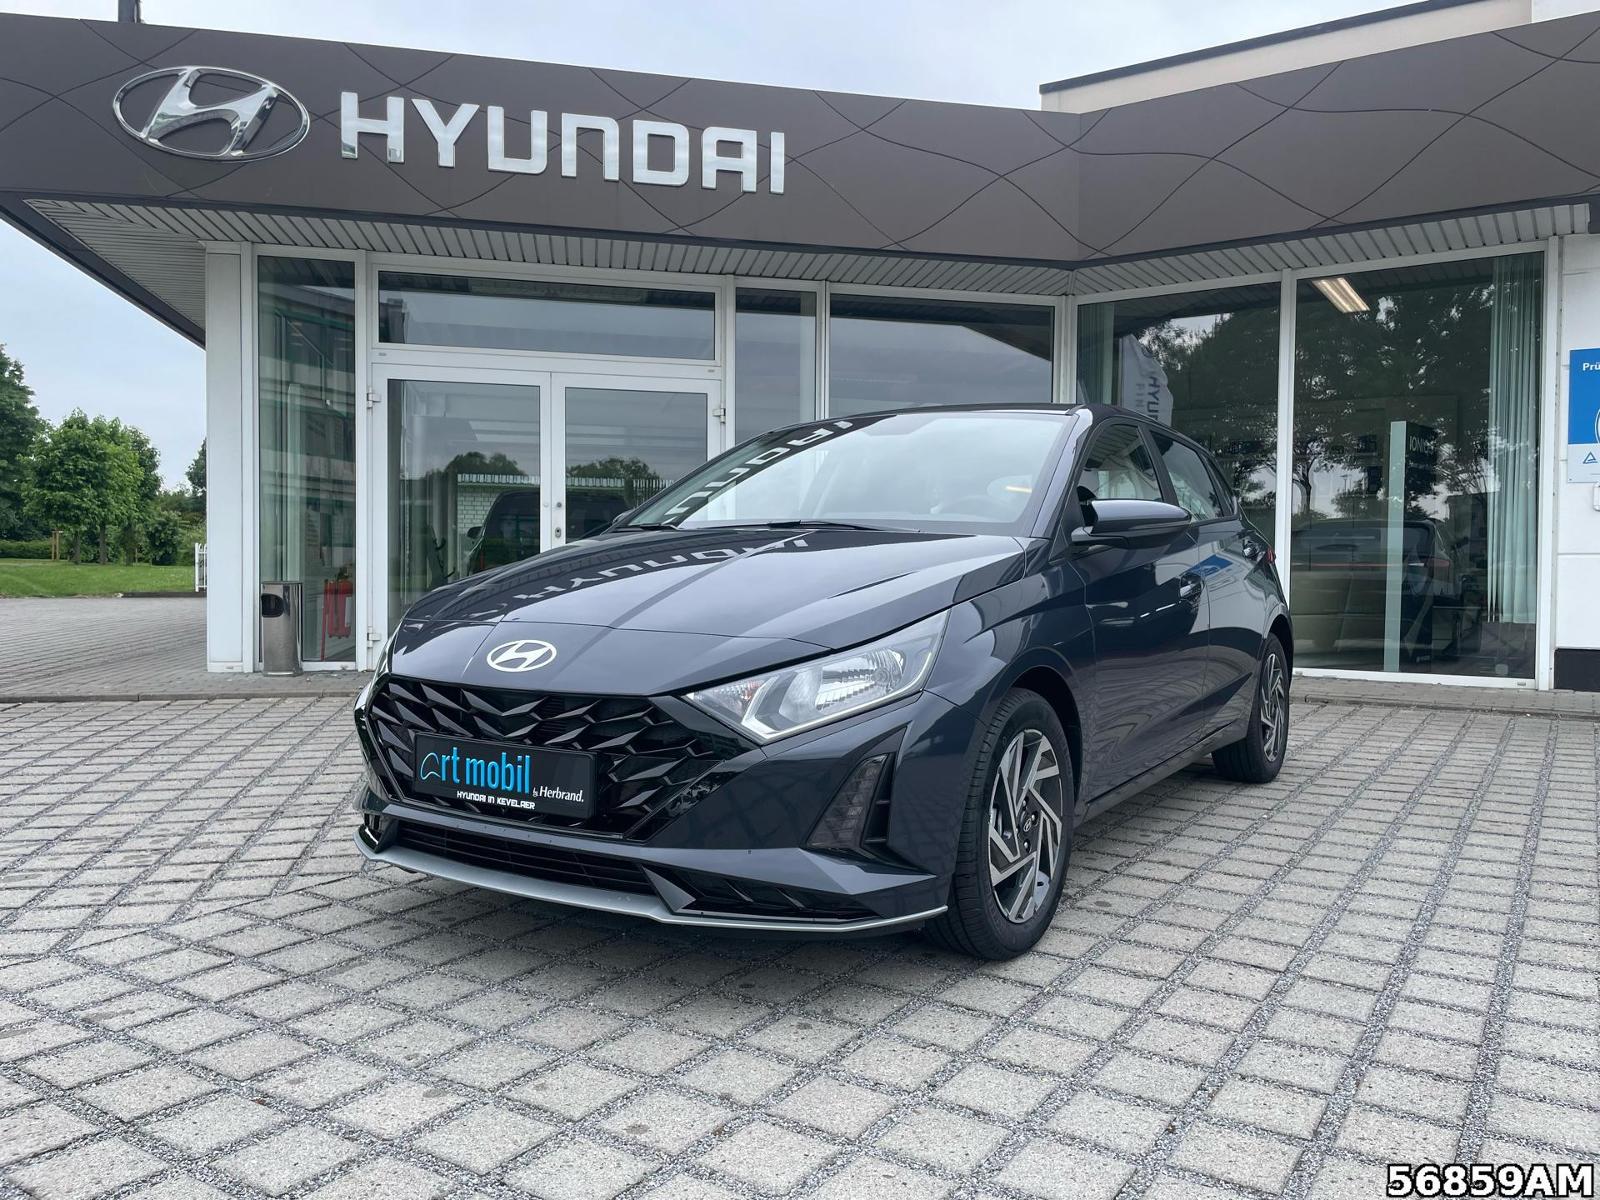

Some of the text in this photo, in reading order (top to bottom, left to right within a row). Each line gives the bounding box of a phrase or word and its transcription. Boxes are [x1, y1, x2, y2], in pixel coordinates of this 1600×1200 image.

[340, 91, 785, 194] HYUNDAI
[456, 790, 487, 803] HYUNDAI
[496, 797, 536, 810] KEVELAER
[465, 751, 531, 794] mobil
[539, 785, 585, 803] Herbrand.
